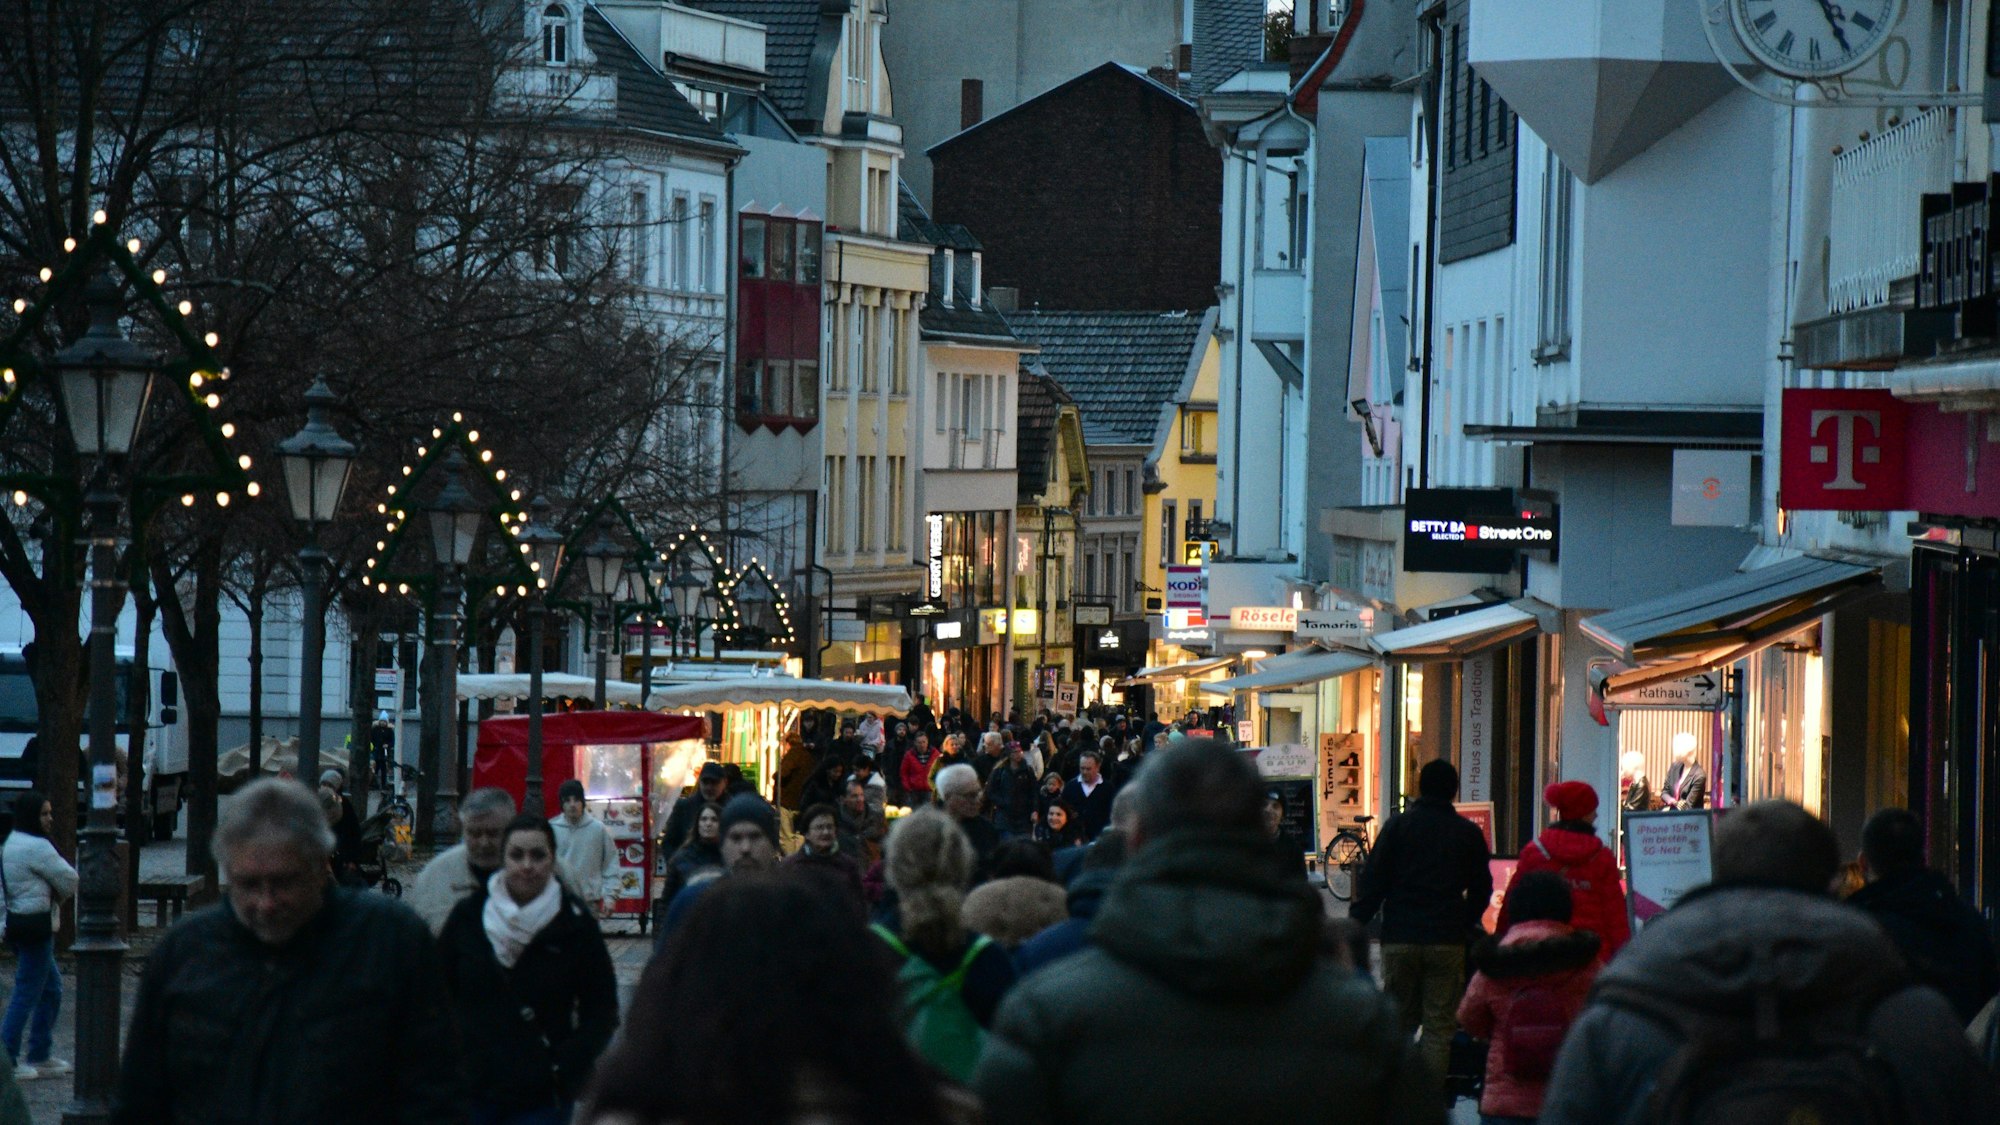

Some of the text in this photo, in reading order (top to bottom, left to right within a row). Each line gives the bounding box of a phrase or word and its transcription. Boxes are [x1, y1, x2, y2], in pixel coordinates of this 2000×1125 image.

[1809, 409, 1882, 491] T
[1410, 520, 1448, 533] BETTY
[1431, 533, 1460, 541] SELECTED
[1240, 609, 1295, 623] Rösele
[1300, 618, 1358, 630] Tamaris
[1470, 660, 1482, 719] Tradition
[1472, 722, 1481, 746] aus
[1266, 759, 1307, 767] BAUM
[1323, 737, 1335, 800] Tamaris
[1470, 751, 1481, 784] Haus
[1637, 825, 1669, 835] iPhone
[1683, 823, 1699, 832] Pro
[1656, 834, 1688, 844] besten
